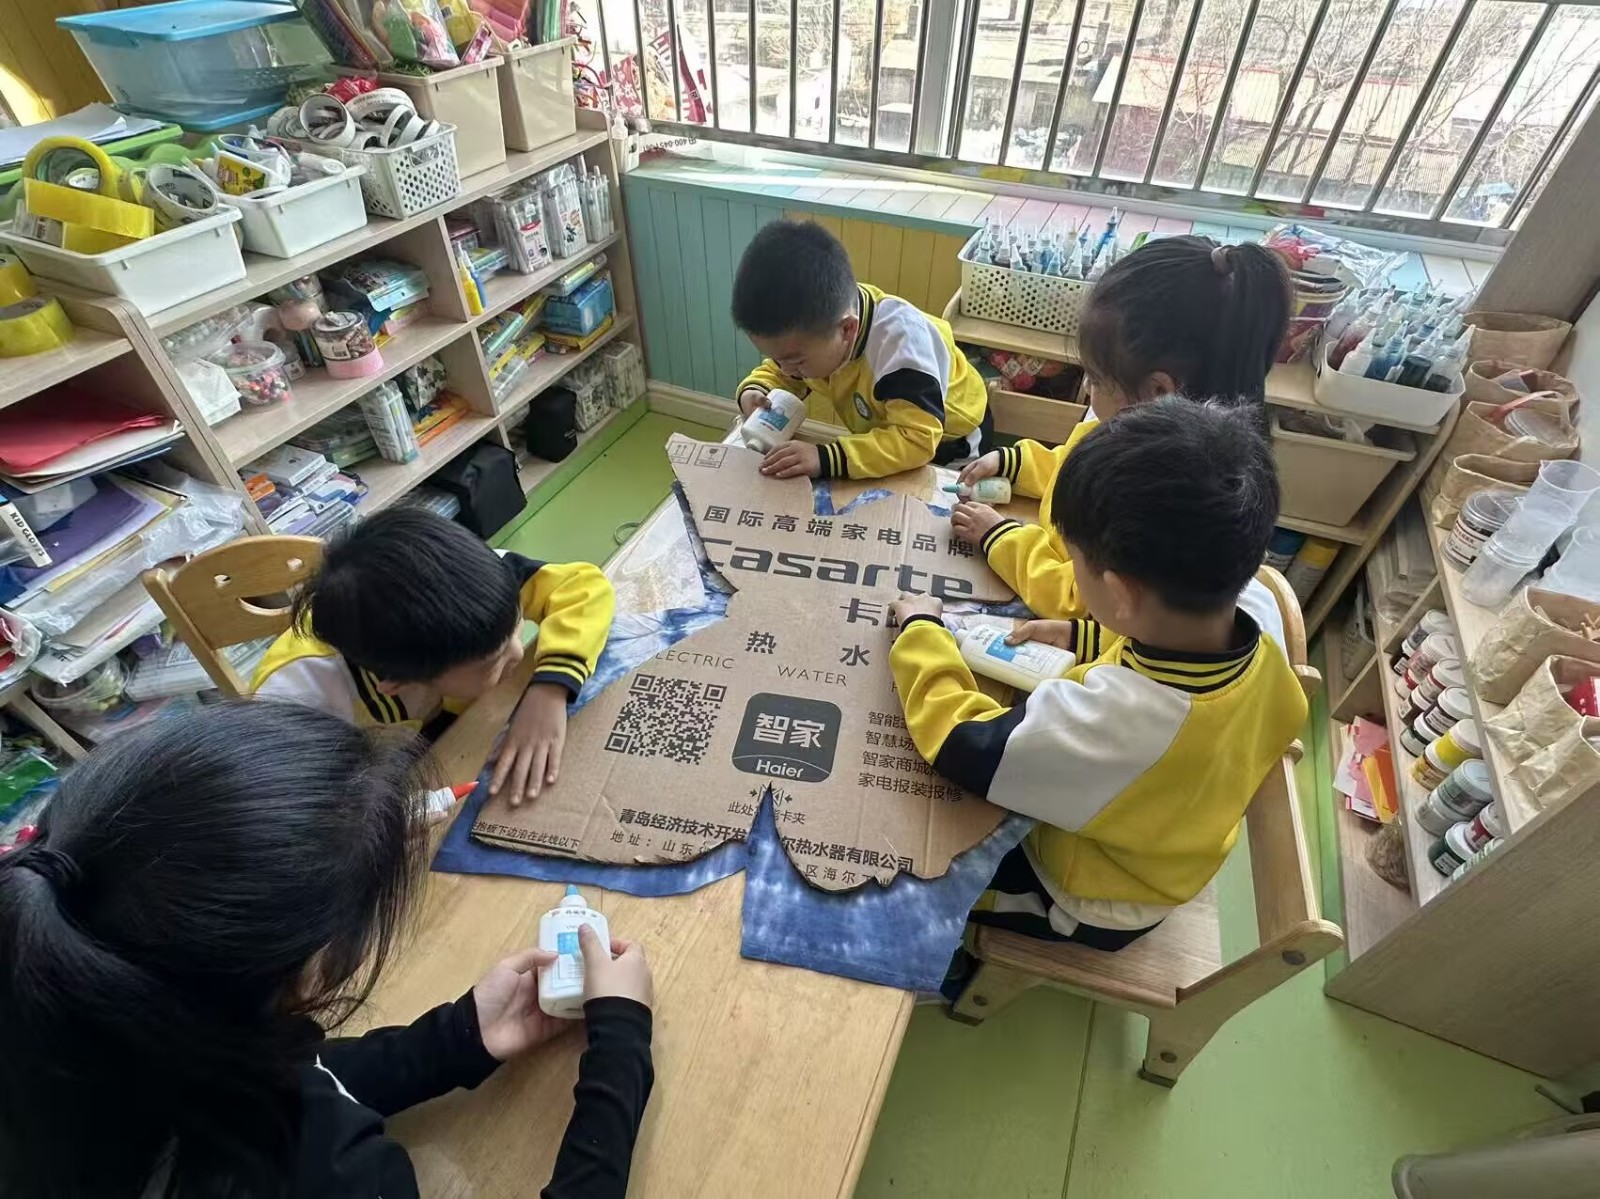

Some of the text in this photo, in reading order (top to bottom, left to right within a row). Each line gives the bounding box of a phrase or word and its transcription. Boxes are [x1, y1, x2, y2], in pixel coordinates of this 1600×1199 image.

[703, 504, 975, 558] 国际高端家电品牌
[777, 665, 847, 686] WATER
[752, 712, 825, 748] 智家
[756, 759, 804, 778] Haier
[862, 750, 938, 776] 智家商城
[858, 772, 964, 802] 家电报装报修
[619, 808, 747, 843] 青岛经济技术开发
